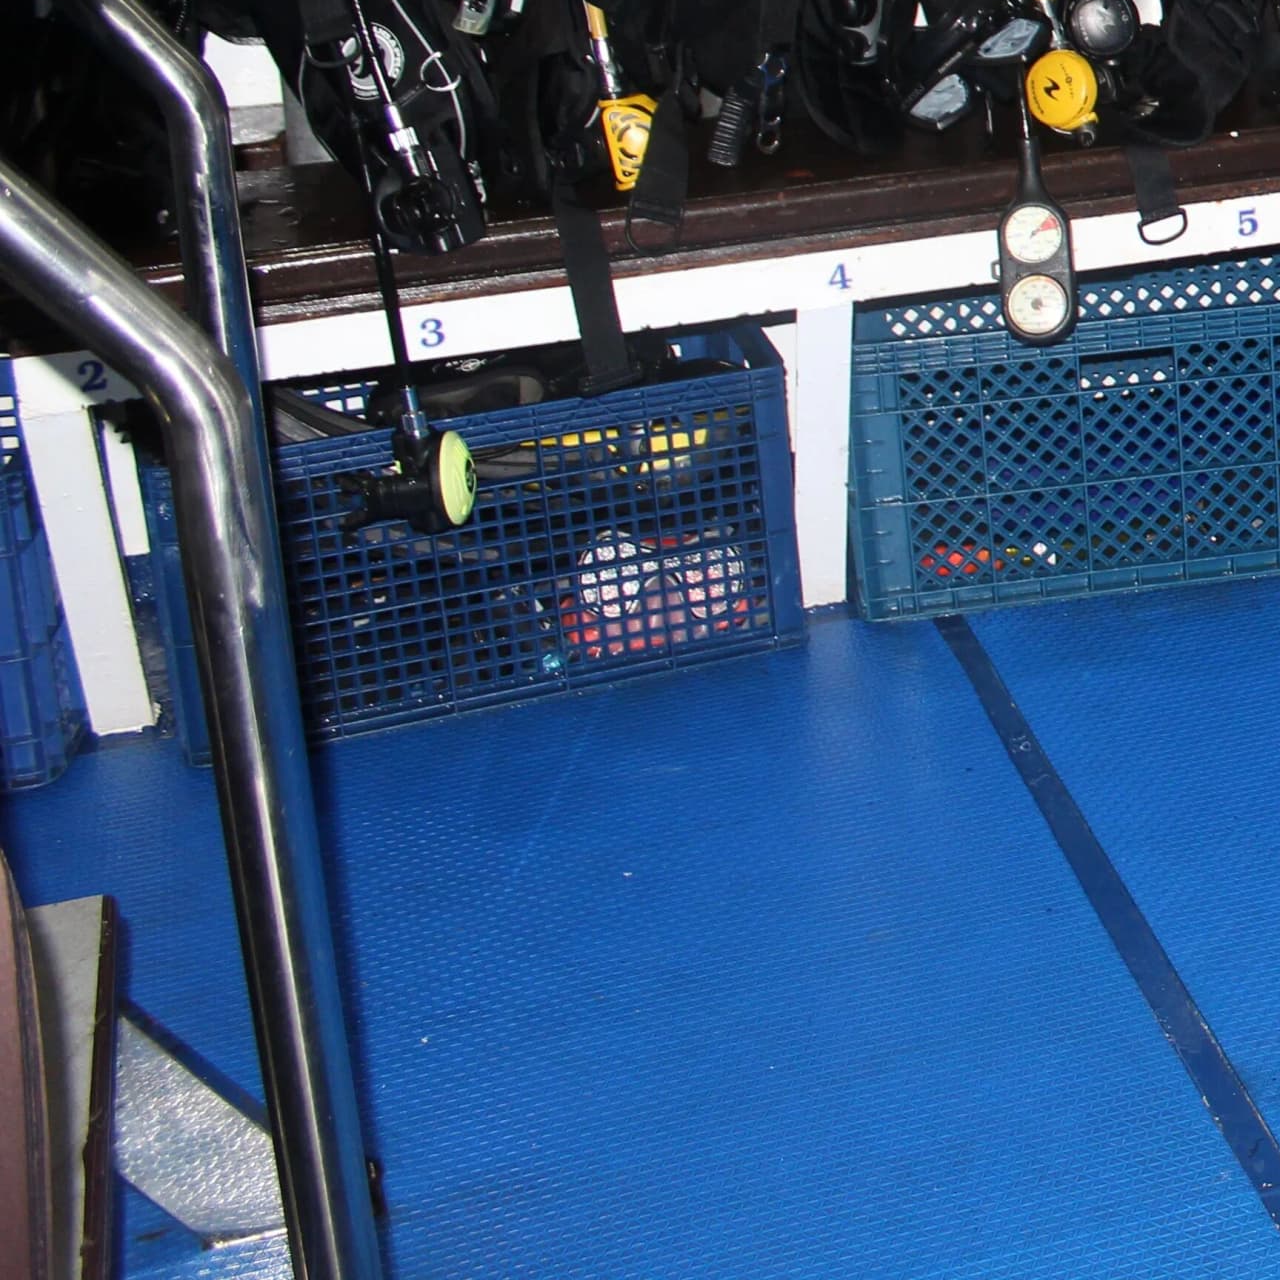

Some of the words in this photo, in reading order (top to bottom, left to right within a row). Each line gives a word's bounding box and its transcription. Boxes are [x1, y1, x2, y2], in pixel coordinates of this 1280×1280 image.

[1238, 208, 1259, 237] 5
[828, 263, 852, 290] 4
[420, 318, 445, 348] 3
[77, 360, 108, 392] 2
